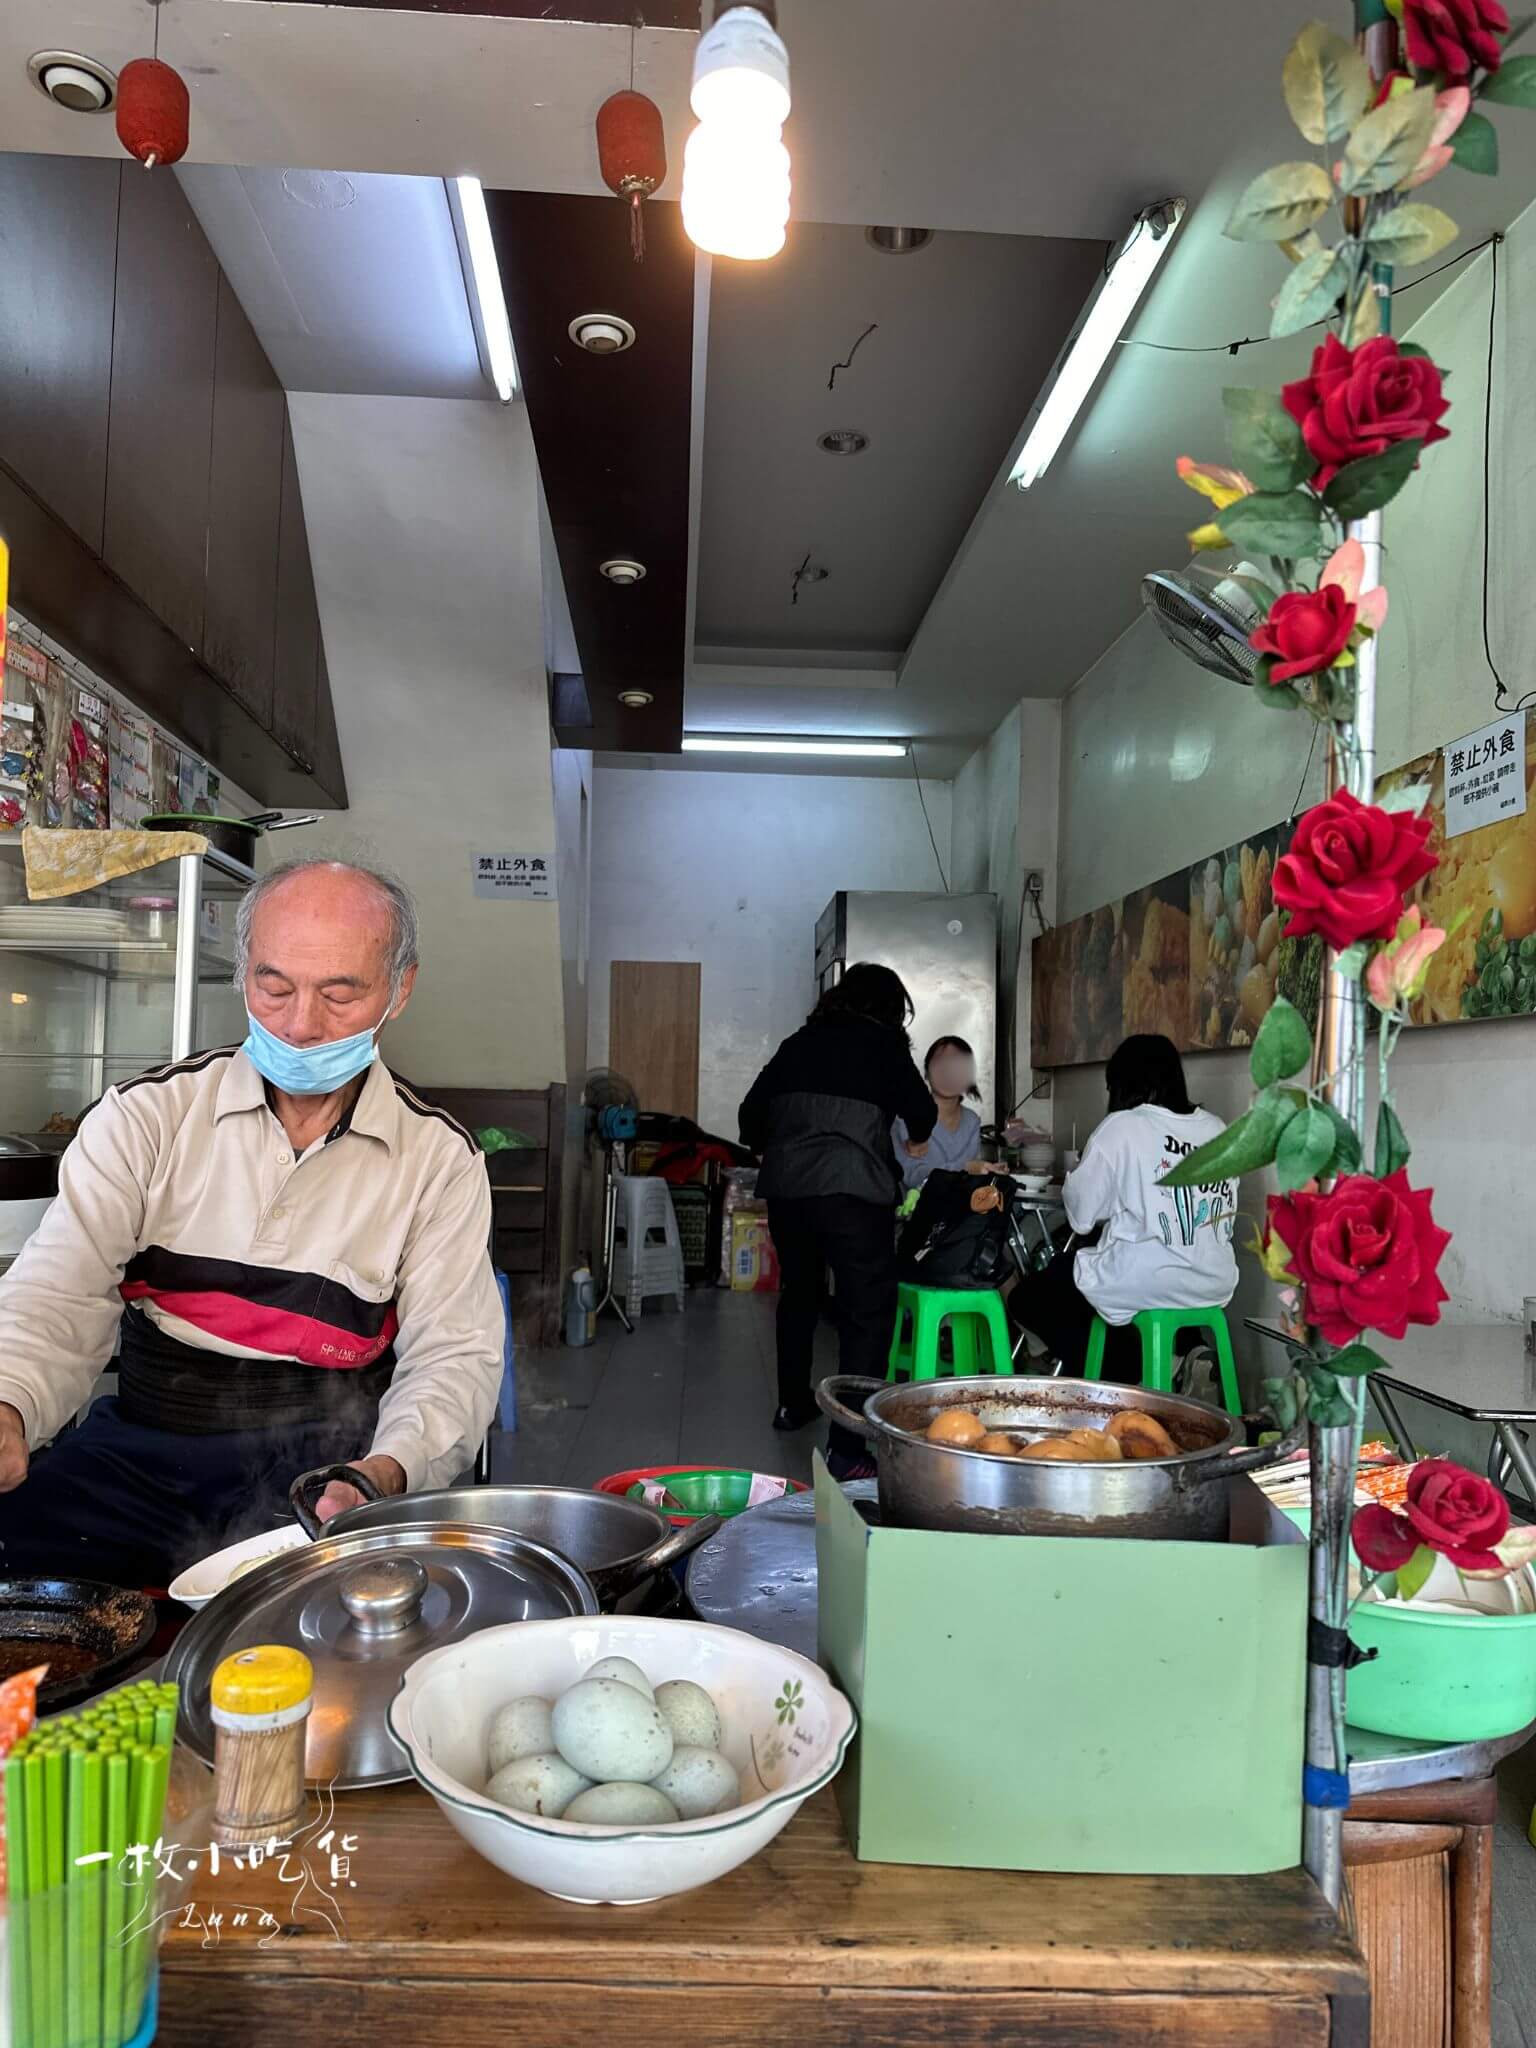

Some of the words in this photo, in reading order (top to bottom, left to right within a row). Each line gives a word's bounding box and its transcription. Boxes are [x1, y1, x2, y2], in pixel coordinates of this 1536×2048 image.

[1450, 729, 1516, 777] 禁止外食
[478, 858, 547, 871] 禁止外食
